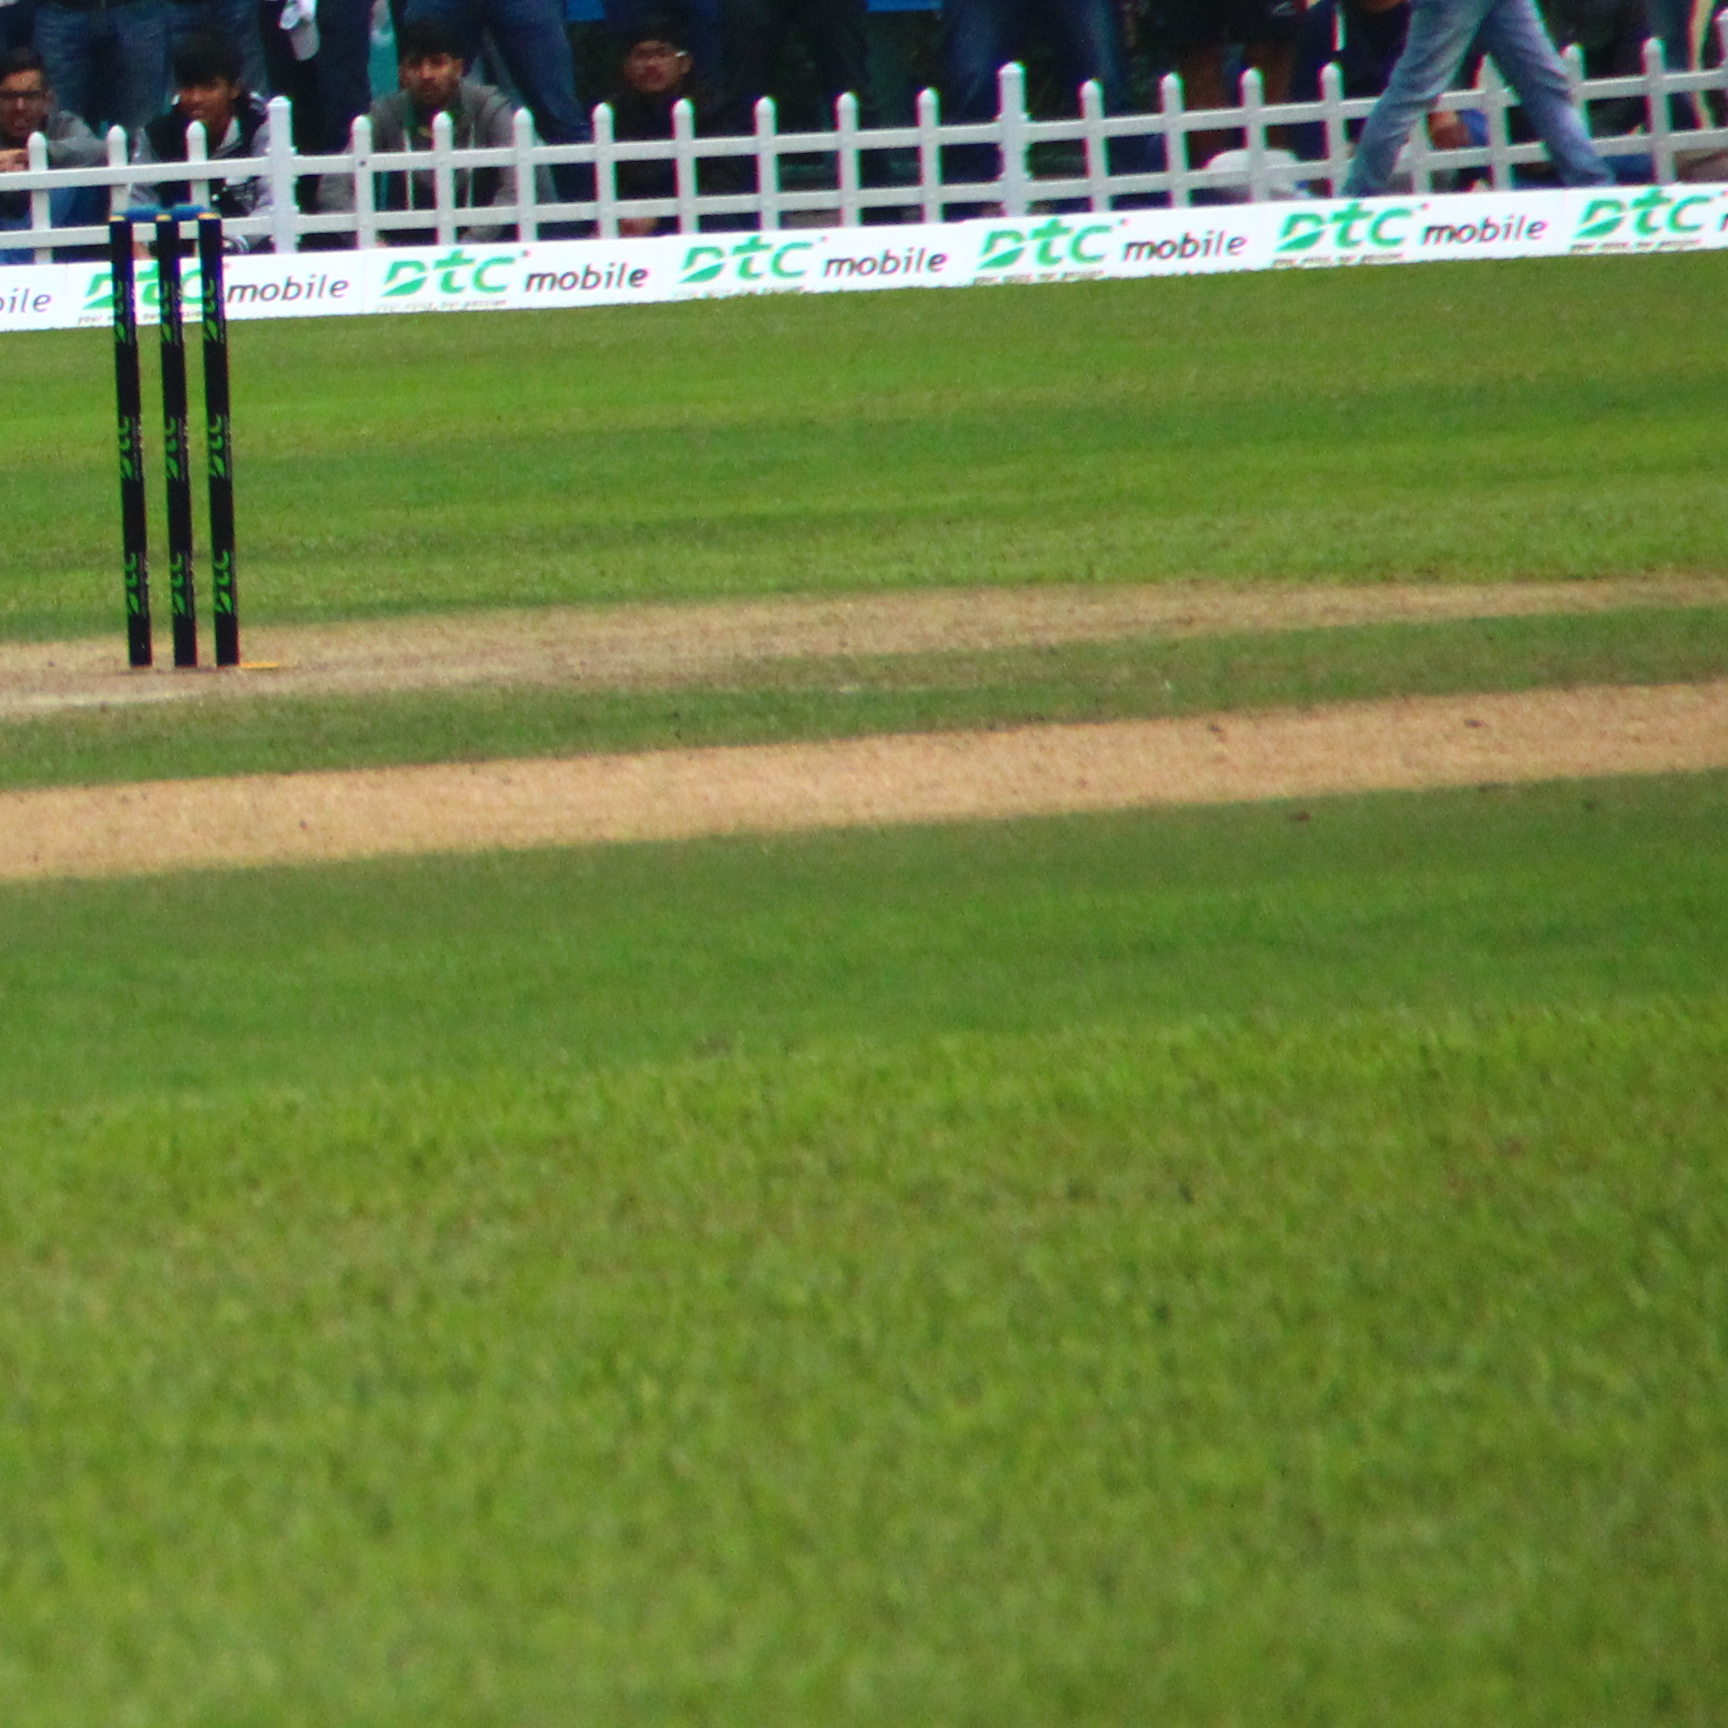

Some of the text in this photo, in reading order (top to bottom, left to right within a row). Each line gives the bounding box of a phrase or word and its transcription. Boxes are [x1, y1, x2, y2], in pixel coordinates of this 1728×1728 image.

[1122, 229, 1247, 262] mobile
[1422, 214, 1548, 246] mobile
[524, 260, 650, 293] mobile
[823, 246, 949, 278] mobile
[226, 272, 349, 304] mobile
